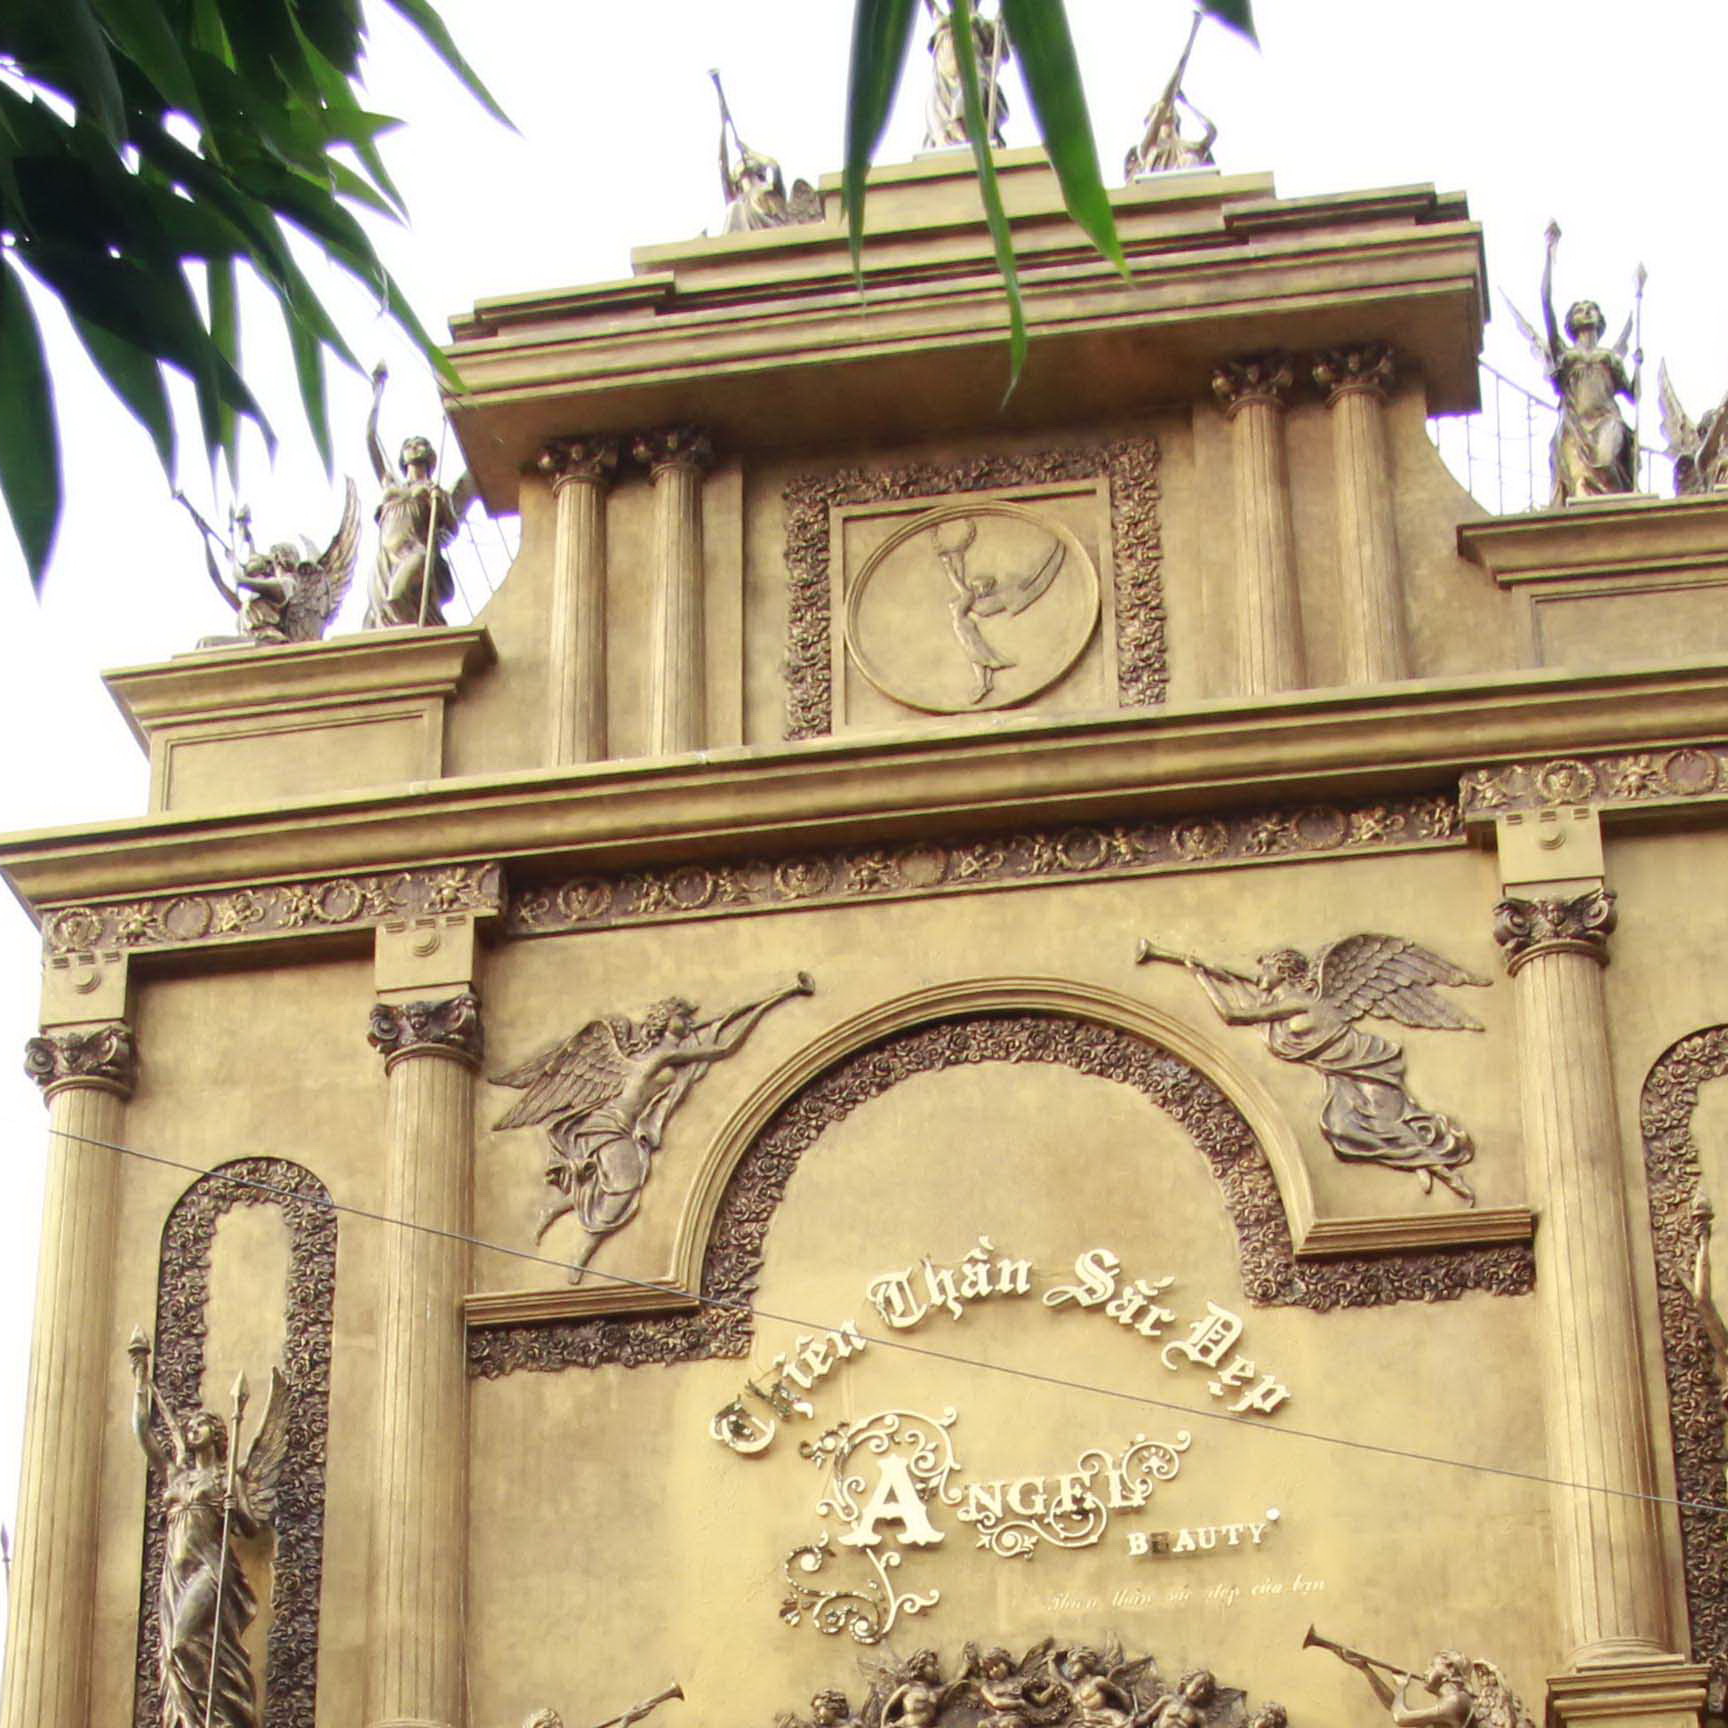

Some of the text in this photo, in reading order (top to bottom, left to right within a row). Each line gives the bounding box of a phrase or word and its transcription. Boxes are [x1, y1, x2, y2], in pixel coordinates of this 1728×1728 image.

[710, 1235, 1292, 1454] Thiên Thần Sắc Đẹp
[838, 1452, 1148, 1550] ANGEL
[1128, 1521, 1270, 1559] BEAUTY
